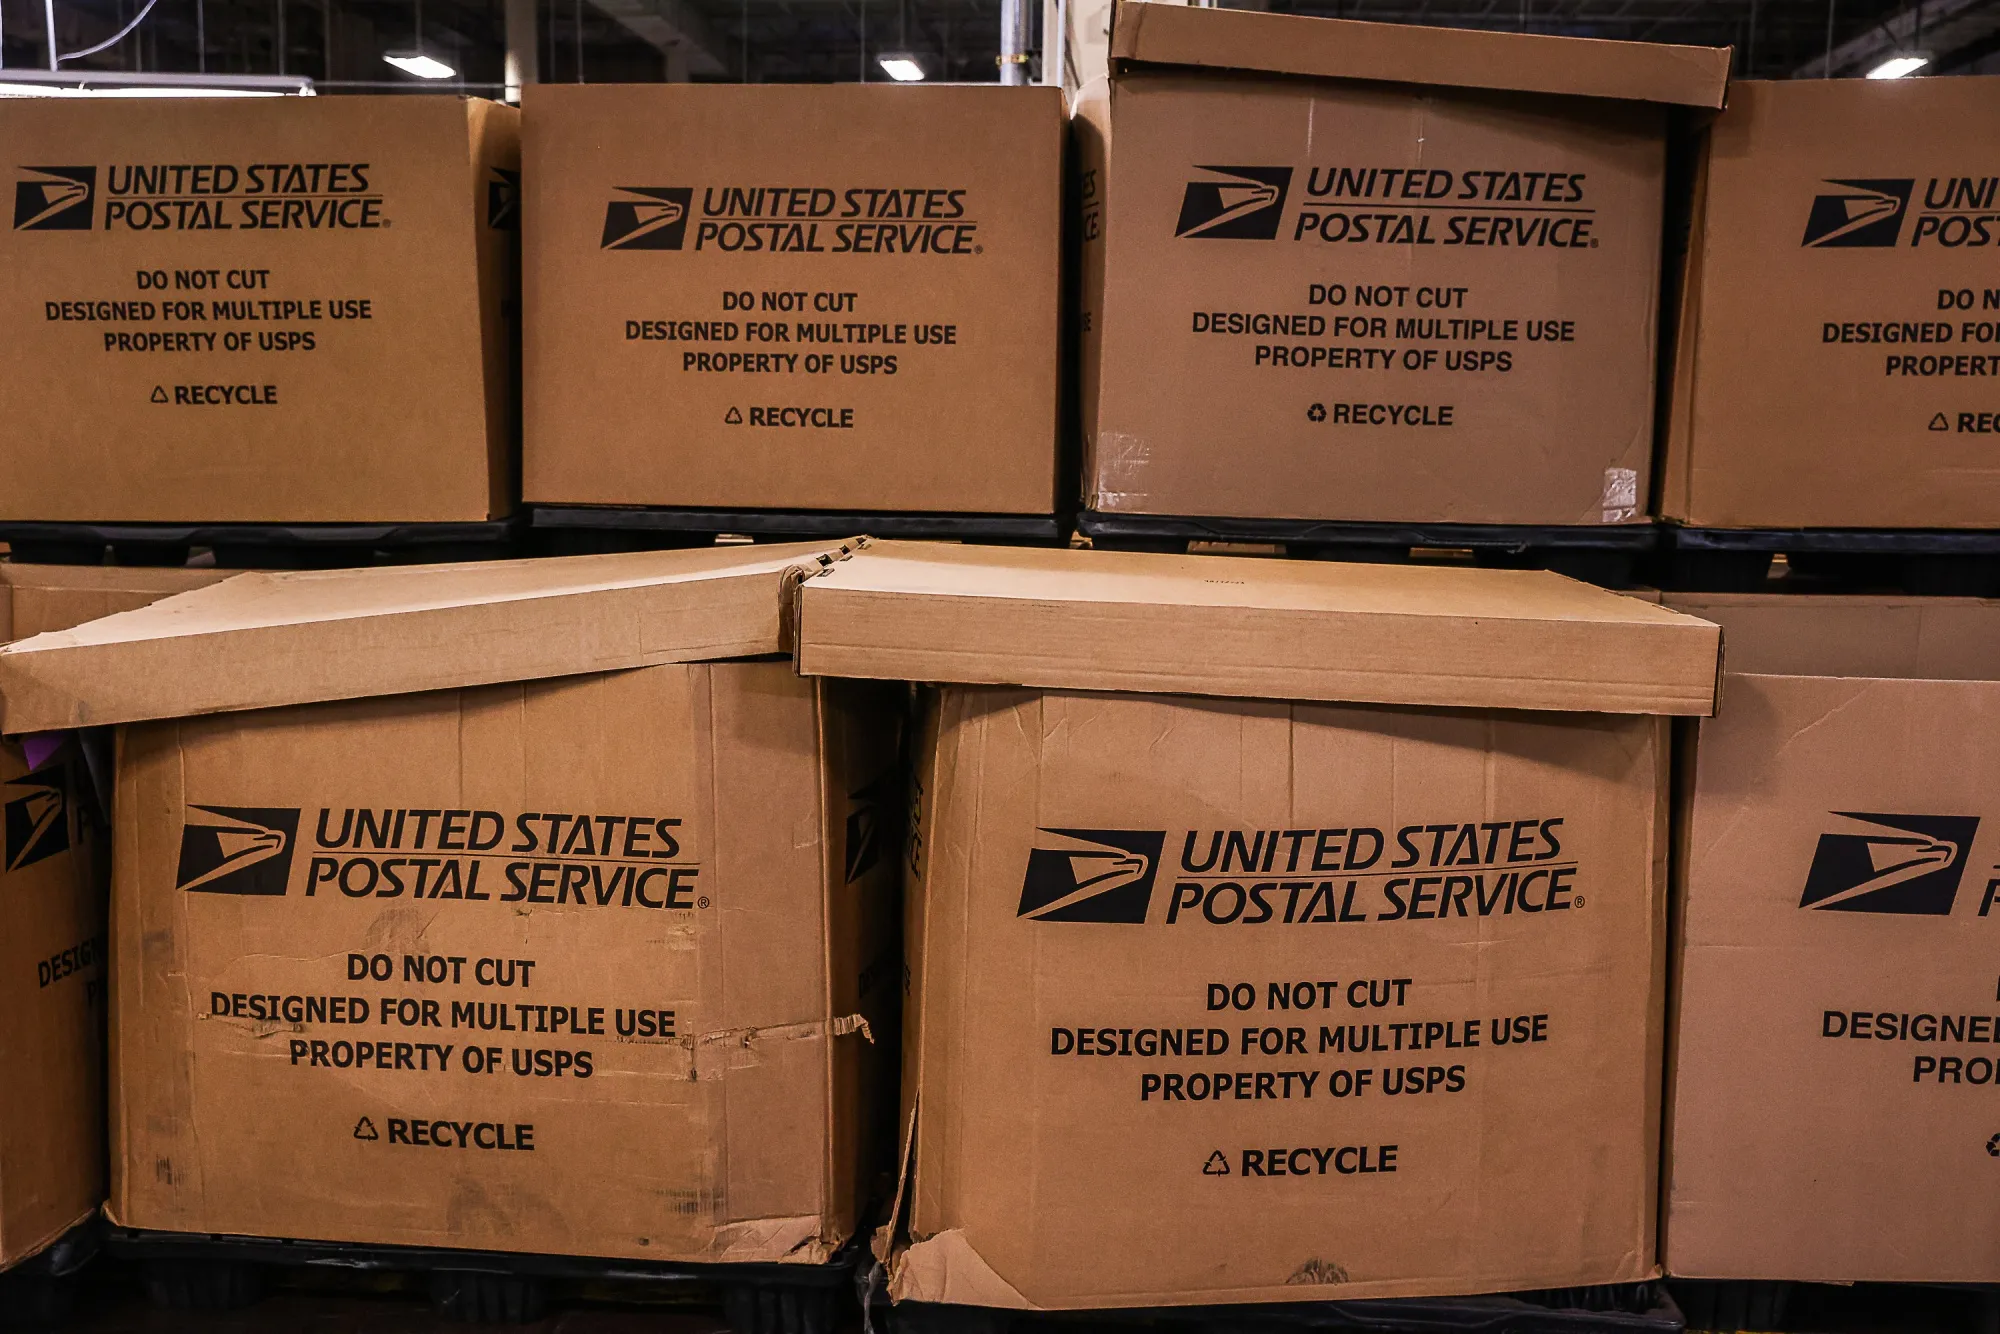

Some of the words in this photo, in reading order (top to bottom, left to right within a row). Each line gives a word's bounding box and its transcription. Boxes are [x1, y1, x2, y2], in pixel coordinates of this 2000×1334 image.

[108, 165, 238, 194] UNITED
[245, 164, 369, 193] STATES
[1307, 167, 1453, 198] UNITED
[1458, 171, 1586, 202] STATES
[105, 201, 232, 230] POSTAL
[703, 188, 835, 216] UNITED
[841, 189, 966, 218] STATES
[695, 222, 824, 252] POSTAL
[1294, 213, 1435, 244] POSTAL
[1911, 216, 2000, 247] POS
[137, 270, 168, 289] DO
[175, 270, 220, 289] NOT
[227, 270, 270, 289] CUT
[46, 302, 155, 320] DESIGNED
[163, 302, 206, 320] FOR
[212, 301, 322, 320] MULTIPLE
[329, 300, 371, 319] USE
[723, 292, 754, 310] DO
[762, 292, 808, 311] NOT
[814, 293, 858, 312] CUT
[1309, 284, 1346, 305] DO
[1355, 286, 1410, 307] NOT
[1417, 287, 1468, 308] CUT
[1938, 289, 1974, 310] DO
[104, 332, 216, 351] PROPERTY
[224, 332, 251, 351] OF
[259, 332, 315, 351] USPS
[626, 321, 738, 341] DESIGNED
[746, 323, 790, 342] FOR
[797, 324, 906, 343] MULTIPLE
[914, 325, 956, 344] USE
[1193, 312, 1325, 336] DESIGNED
[1334, 317, 1386, 338] FOR
[1396, 319, 1518, 340] MULTIPLE
[1527, 321, 1574, 341] USE
[1823, 323, 1952, 343] DESIGNED
[1961, 322, 2000, 343] FO
[684, 352, 798, 372] PROPERTY
[805, 354, 833, 373] OF
[841, 355, 897, 374] USPS
[1256, 346, 1396, 369] PROPERTY
[1403, 350, 1438, 370] OF
[1446, 351, 1512, 371] USPS
[175, 386, 277, 404] RECYCLE
[750, 407, 853, 428] RECYCLE
[1334, 404, 1453, 425] RECYCLE
[316, 808, 504, 850] UNITED
[512, 813, 682, 858] STATES
[1181, 828, 1384, 873] UNITED
[1391, 818, 1564, 868] STATES
[306, 857, 490, 900] POSTAL
[1166, 881, 1366, 924] POSTAL
[348, 954, 393, 981] DO
[404, 955, 466, 984] NOT
[475, 958, 535, 987] CUT
[1207, 983, 1255, 1010] DO
[1268, 982, 1338, 1010] NOT
[1347, 979, 1412, 1008] CUT
[211, 992, 369, 1025] DESIGNED
[381, 998, 442, 1027] FOR
[452, 1001, 604, 1035] MULTIPLE
[616, 1009, 675, 1037] USE
[1823, 1011, 2000, 1043] DESIGNE
[1052, 1028, 1229, 1056] DESIGNED
[1241, 1028, 1308, 1055] FOR
[1319, 1020, 1480, 1053] MULTIPLE
[1492, 1014, 1548, 1045] USE
[290, 1040, 454, 1071] PROPERTY
[462, 1046, 502, 1074] OF
[512, 1049, 593, 1078] USPS
[1913, 1056, 2000, 1084] PRO
[1142, 1071, 1320, 1101] PROPERTY
[1329, 1070, 1372, 1097] OF
[1383, 1065, 1465, 1095] USPS
[388, 1118, 534, 1150] RECYCLE
[1242, 1145, 1398, 1176] RECYCLE
